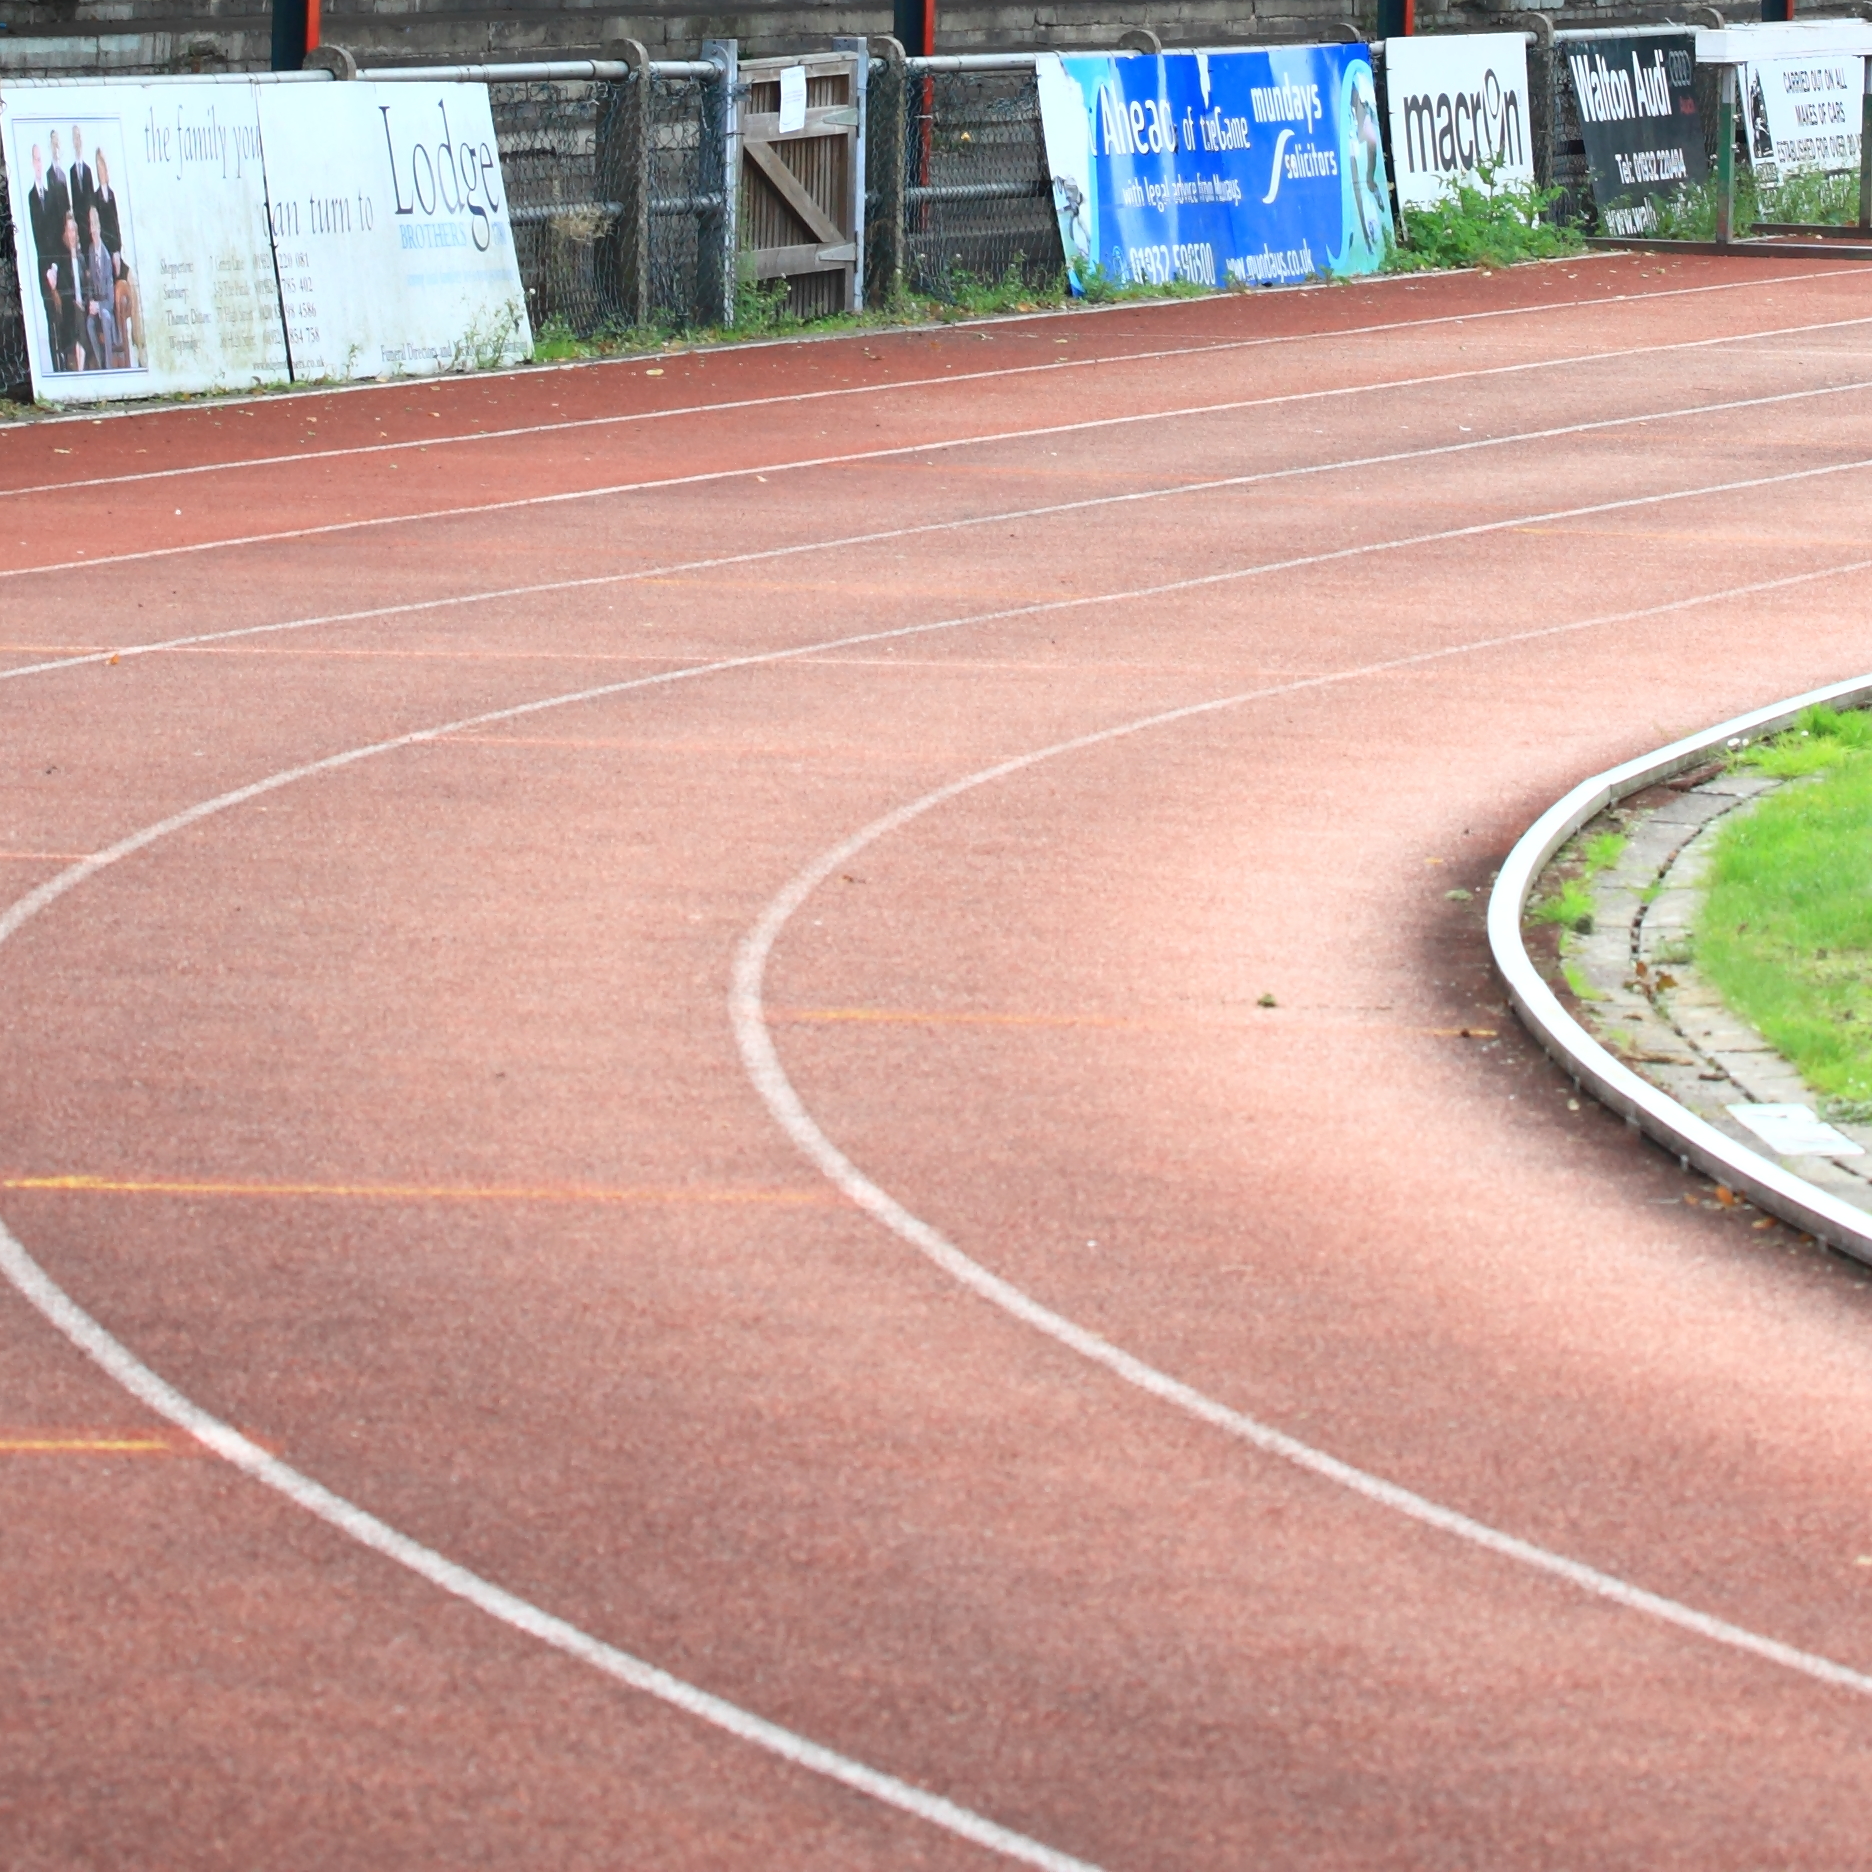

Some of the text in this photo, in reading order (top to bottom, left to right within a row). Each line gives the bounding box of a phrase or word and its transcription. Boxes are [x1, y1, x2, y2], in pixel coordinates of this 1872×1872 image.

[1570, 49, 1672, 123] Walton Audi
[1783, 67, 1848, 95] CARRIED OUT ON ALL
[1250, 72, 1322, 135] mundays
[1403, 68, 1524, 174] macron
[1795, 101, 1845, 127] MAKES OF CARS
[145, 104, 262, 181] the family you
[1183, 106, 1196, 151] of
[1214, 105, 1251, 150] Game
[1776, 138, 1816, 164] ESTABLISHED
[1815, 136, 1831, 159] FOR
[1829, 134, 1846, 158] OVER
[378, 98, 500, 253] Lodge
[1284, 142, 1338, 179] solicitors
[261, 187, 374, 238] can turn to
[1123, 177, 1145, 207] with
[1144, 175, 1170, 213] legal
[398, 222, 467, 250] BROTHERS
[380, 343, 407, 363] Funeral
[406, 341, 438, 361] Directors
[439, 340, 453, 358] and
